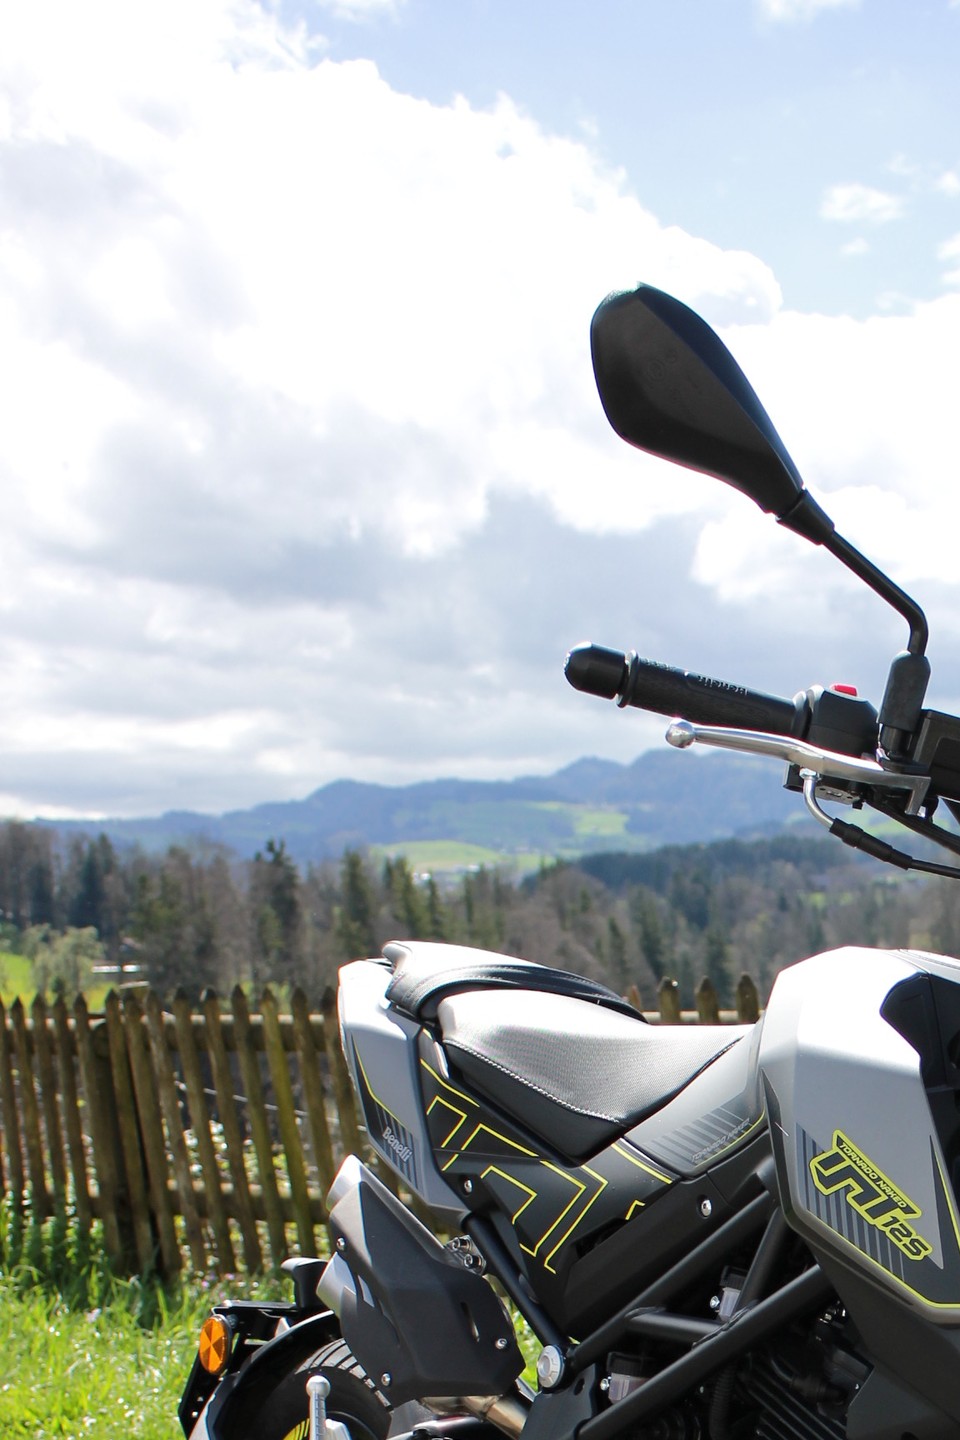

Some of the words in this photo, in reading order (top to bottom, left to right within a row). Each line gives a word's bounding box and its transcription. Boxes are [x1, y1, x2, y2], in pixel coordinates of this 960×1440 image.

[382, 1126, 413, 1162] Benelli
[839, 1141, 879, 1180] TORNADO
[875, 1180, 908, 1209] NAKED
